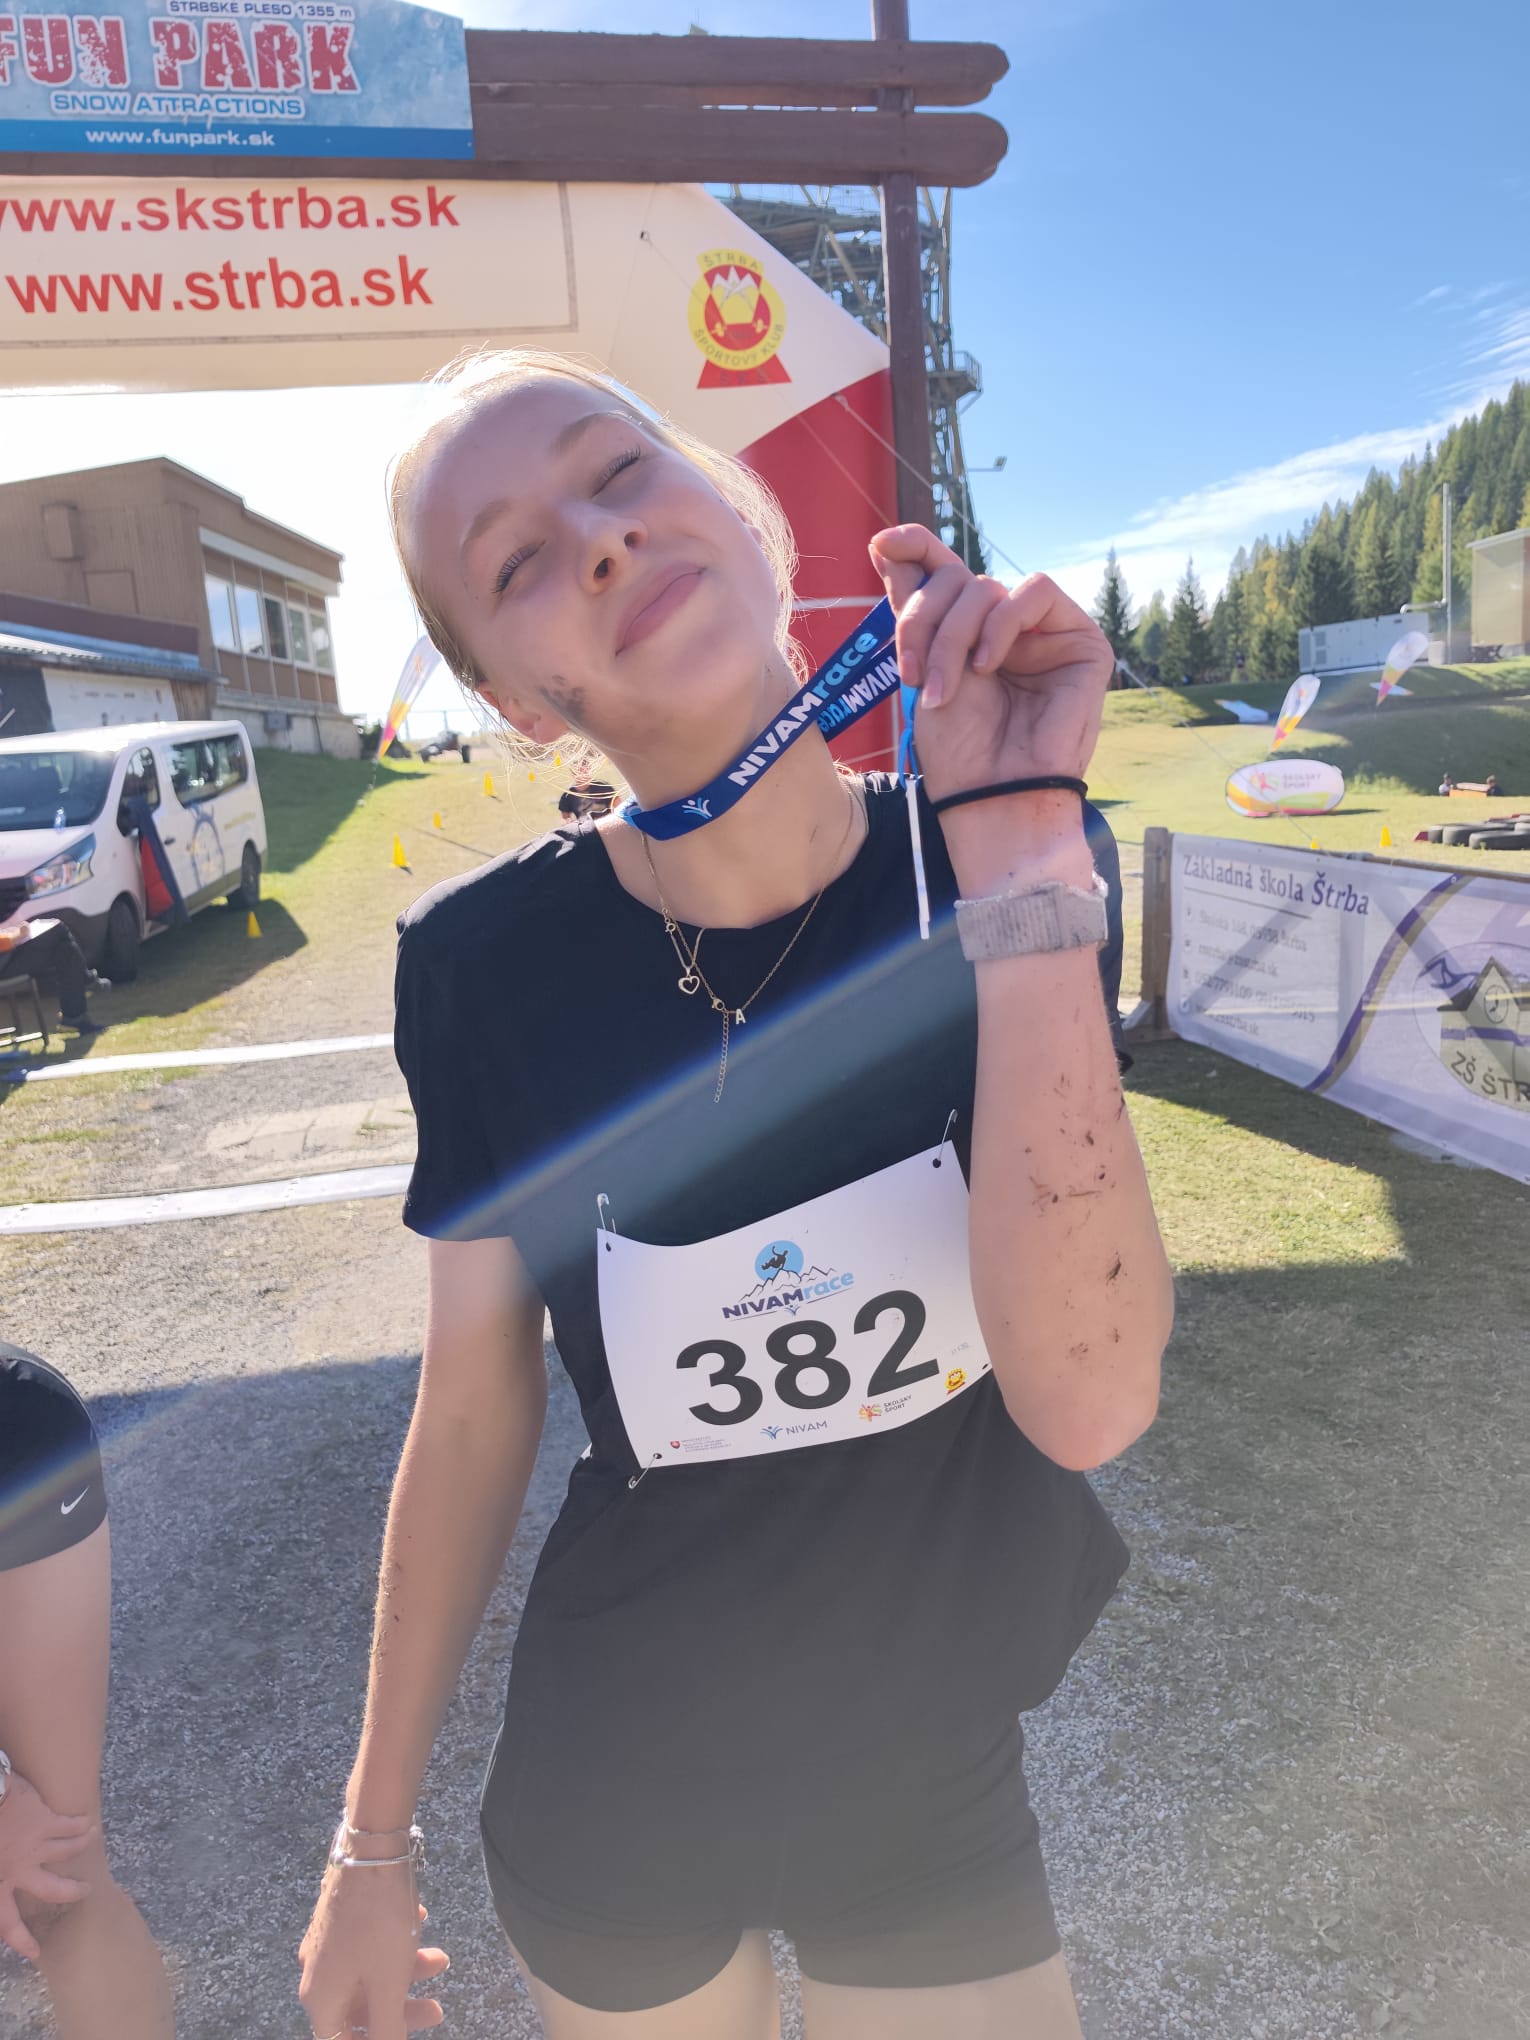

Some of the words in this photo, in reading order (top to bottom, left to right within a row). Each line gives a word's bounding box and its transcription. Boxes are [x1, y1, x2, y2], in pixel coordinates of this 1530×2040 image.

[245, 4, 292, 15] PLESO
[298, 5, 335, 17] 1355
[152, 20, 359, 91] PARK
[53, 94, 128, 111] SNOW
[136, 96, 303, 116] ATTRACTIONS
[85, 129, 276, 148] www.funpark.sk
[0, 185, 461, 232] ww.skstrba.sk
[5, 254, 434, 313] www.strba.sk
[1183, 854, 1253, 890] Základná
[1259, 866, 1304, 903] škola
[1311, 871, 1370, 916] Štrba
[676, 1289, 940, 1426] 382
[785, 1420, 828, 1436] NIVAM
